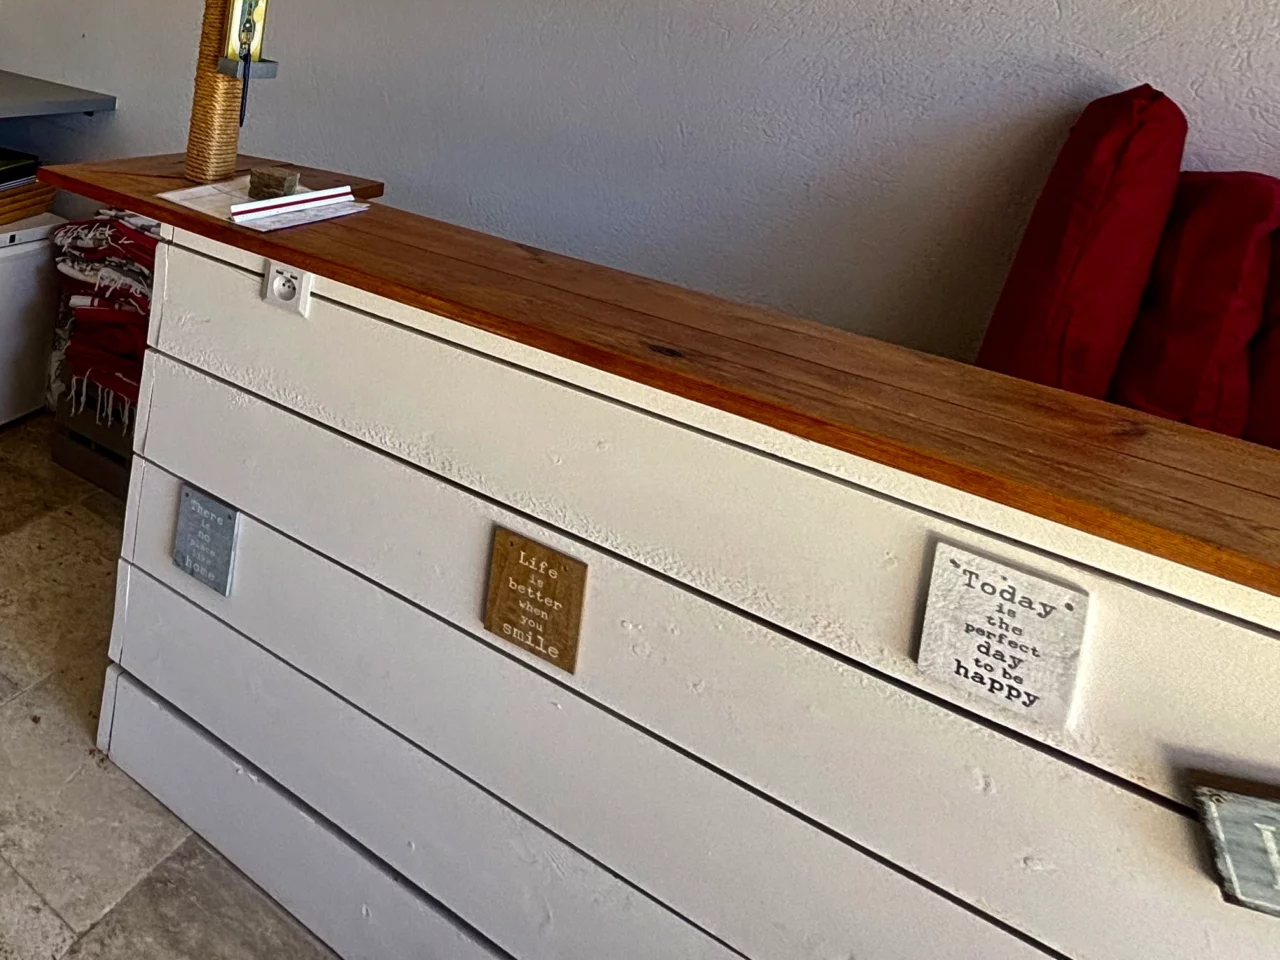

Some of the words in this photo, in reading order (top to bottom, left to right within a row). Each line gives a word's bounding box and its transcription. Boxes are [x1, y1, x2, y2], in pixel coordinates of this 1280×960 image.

[190, 499, 224, 526] There
[198, 530, 211, 542] no
[185, 555, 216, 581] home
[519, 550, 558, 579] Life
[508, 576, 563, 611] better
[530, 574, 544, 588] is
[962, 568, 1057, 619] Today
[518, 599, 549, 620] when
[995, 602, 1017, 619] is
[520, 615, 544, 633] you
[986, 615, 1023, 636] the
[502, 623, 560, 659] smile
[964, 622, 1041, 658] perfect
[977, 640, 1024, 670] day
[953, 658, 1040, 708] happy
[973, 657, 995, 673] to
[1002, 667, 1024, 685] be
